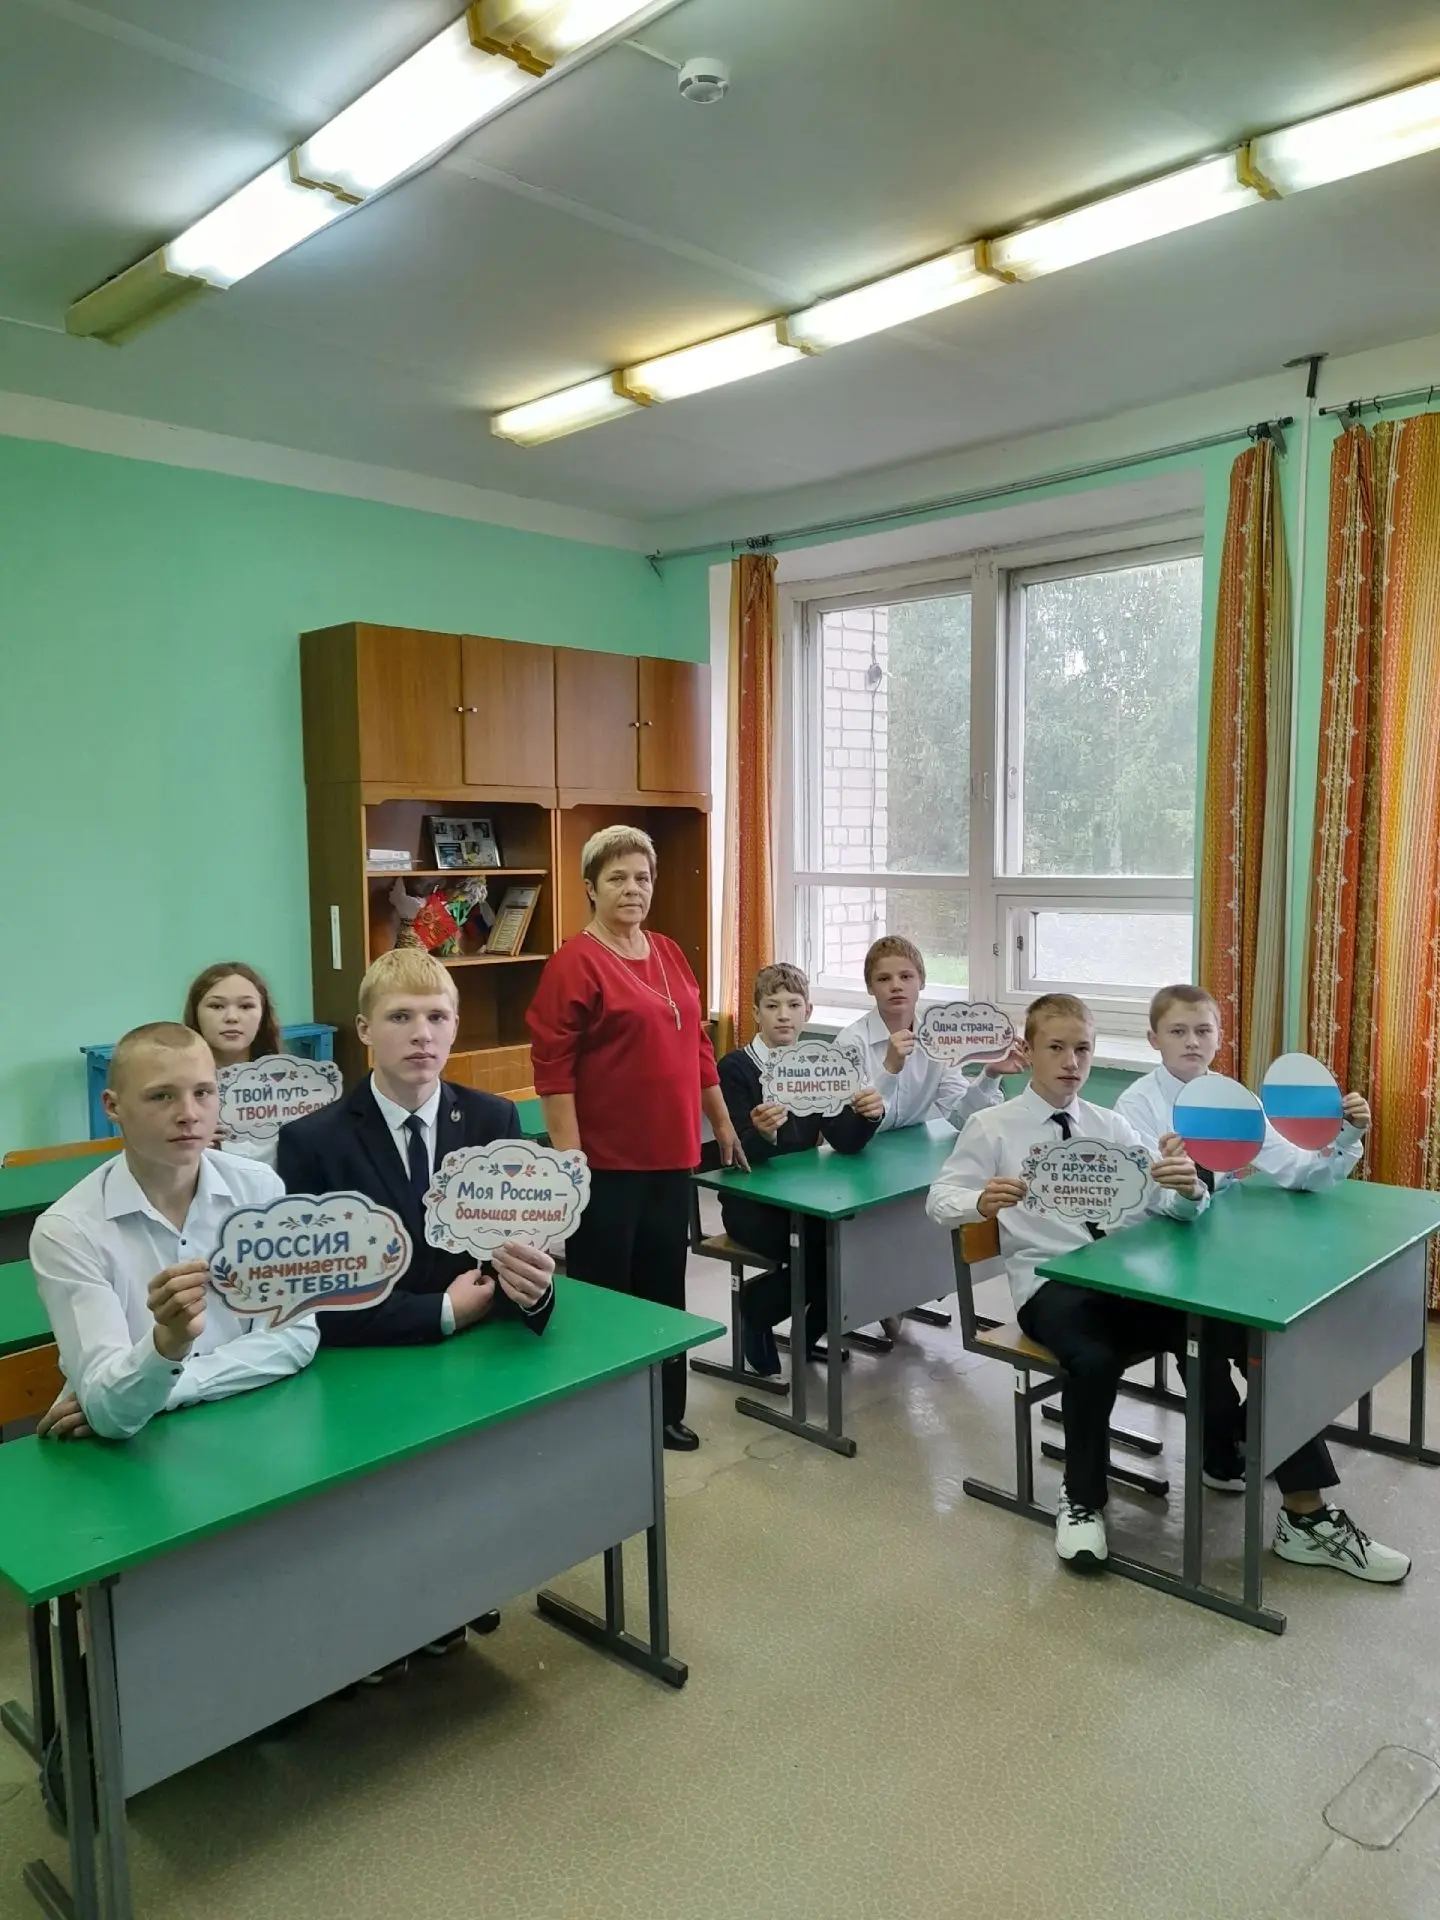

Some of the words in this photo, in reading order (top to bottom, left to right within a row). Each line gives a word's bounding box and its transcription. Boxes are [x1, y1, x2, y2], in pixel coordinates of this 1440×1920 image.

[932, 1020, 958, 1032] Одна
[960, 1022, 994, 1033] страна
[937, 1035, 963, 1045] одна
[965, 1033, 998, 1045] мечта!
[777, 1066, 811, 1078] Наша
[814, 1066, 847, 1077] СИЛА
[232, 1084, 273, 1104] ТВОЙ
[276, 1086, 309, 1102] путь
[776, 1082, 784, 1092] в
[786, 1080, 851, 1094] ЕДИНСТВЕ!
[236, 1104, 278, 1121] ТВОИ
[1062, 1161, 1118, 1174] дружбы
[1050, 1172, 1059, 1182] в
[1062, 1172, 1112, 1183] классе
[457, 1181, 494, 1201] Моя
[500, 1180, 552, 1201] Россия
[1053, 1184, 1119, 1197] единству
[1053, 1196, 1112, 1207] страны!
[455, 1201, 517, 1222] большая
[521, 1202, 568, 1222] семья!
[237, 1231, 350, 1264] РОССИЯ
[249, 1255, 368, 1281] начинается
[258, 1281, 270, 1294] с
[284, 1272, 359, 1295] ТЕБЯ!
